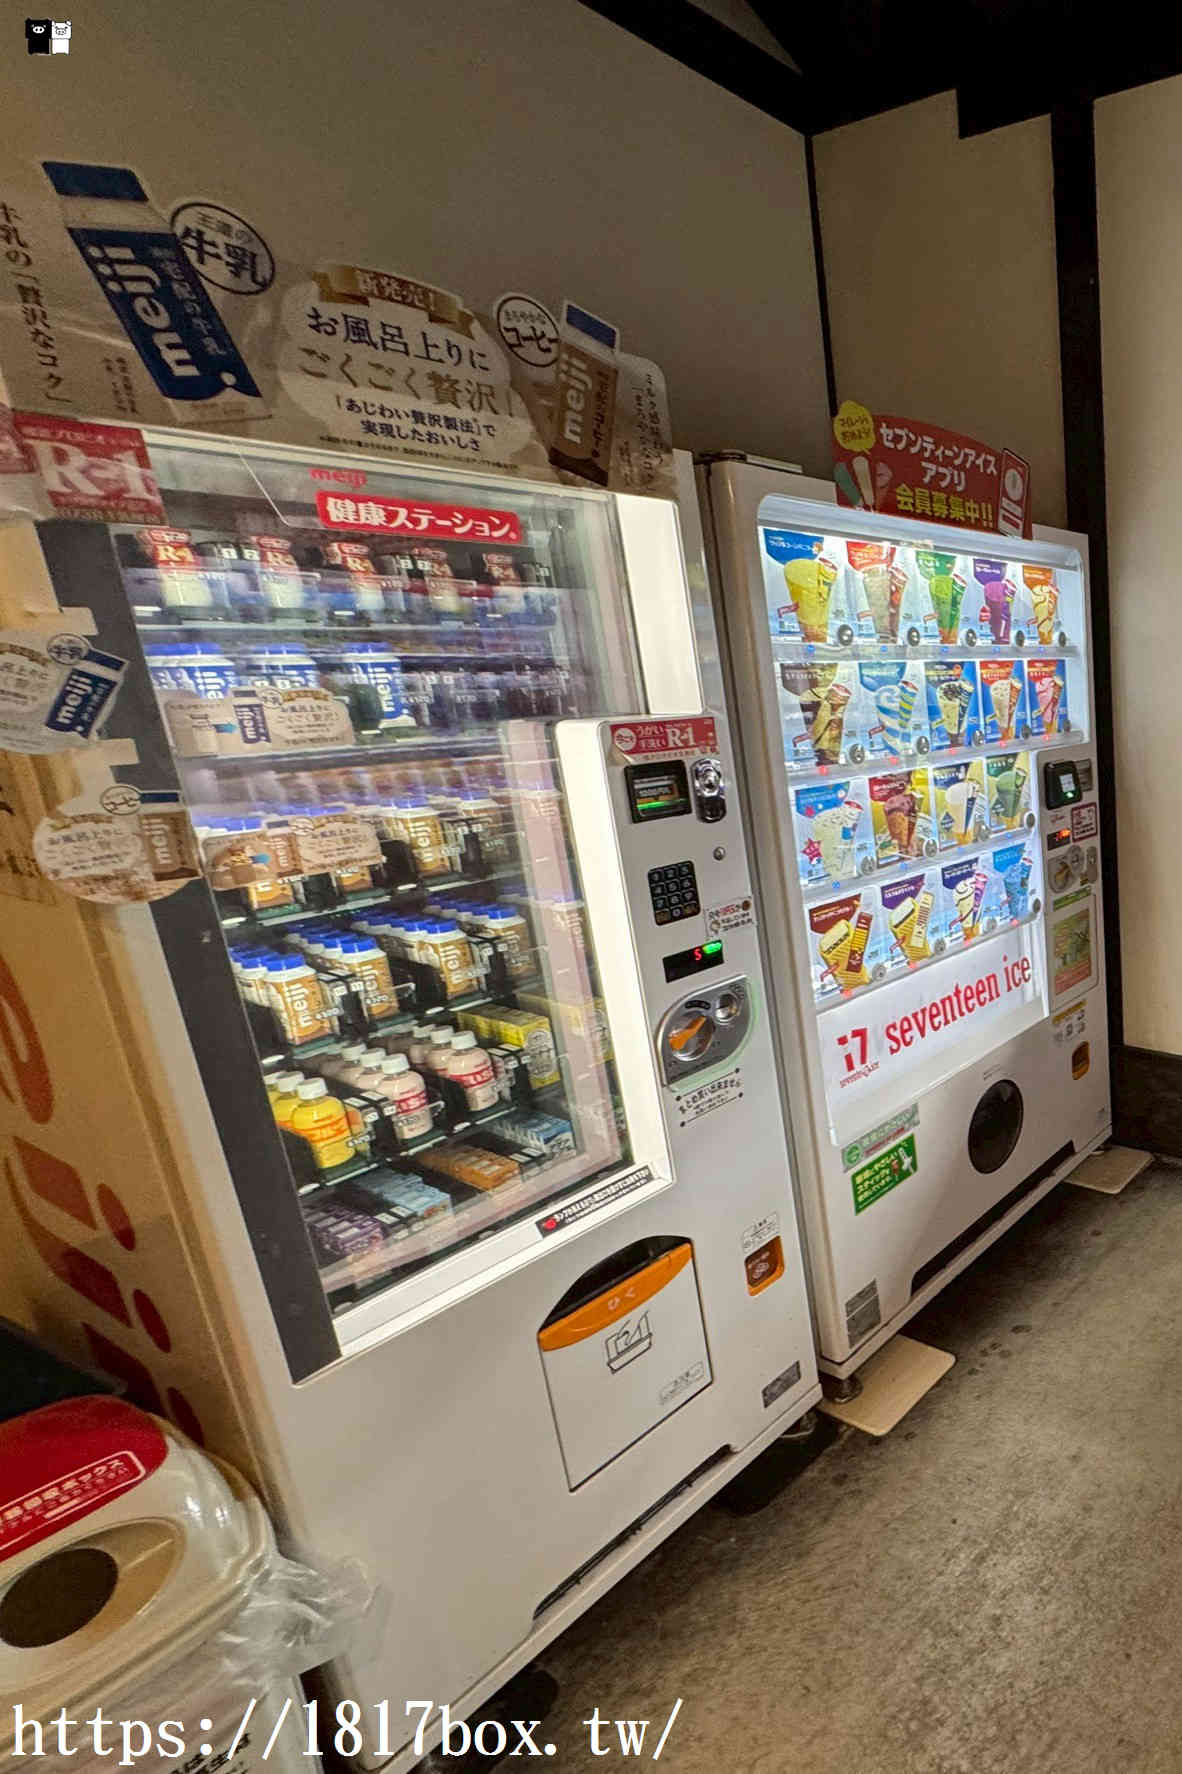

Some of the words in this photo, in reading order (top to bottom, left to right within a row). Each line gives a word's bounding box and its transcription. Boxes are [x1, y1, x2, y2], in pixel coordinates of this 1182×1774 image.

[87, 244, 201, 378] meiji
[306, 306, 489, 371] お風呂上りに
[502, 325, 561, 353] コーヒー
[558, 352, 593, 445] meiji
[359, 420, 481, 453] 実現したおいしさ
[879, 421, 998, 476] セブンティーンアイス
[308, 467, 368, 489] meiji
[919, 460, 967, 492] アプリ
[367, 666, 395, 713] meiji
[665, 727, 698, 749] R-1
[408, 820, 433, 863] meiji
[286, 983, 313, 1029] meiji
[885, 972, 1001, 1056] seventeen
[1004, 954, 1032, 992] ice
